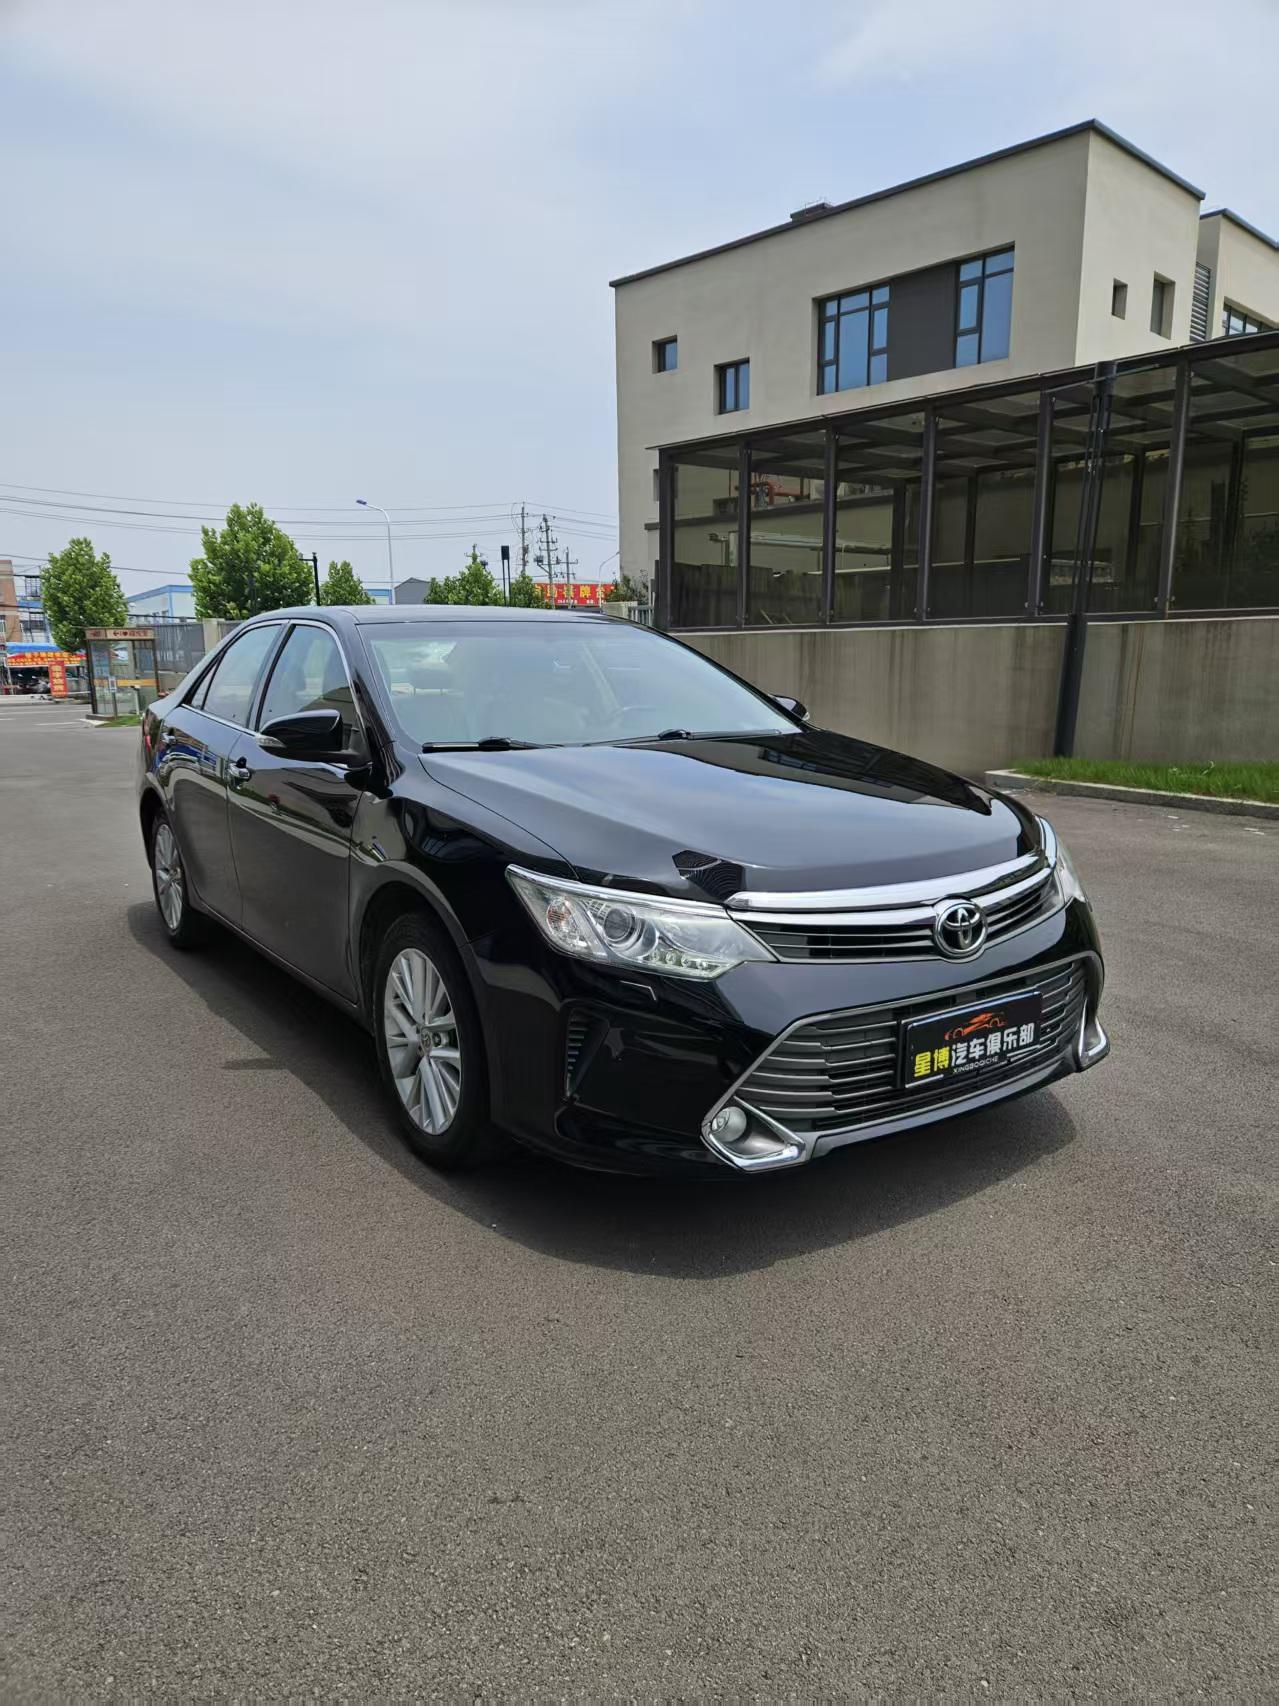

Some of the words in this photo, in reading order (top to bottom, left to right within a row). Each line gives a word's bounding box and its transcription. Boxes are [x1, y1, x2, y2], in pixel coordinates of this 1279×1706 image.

[914, 1022, 1035, 1078] 星博汽车俱乐部
